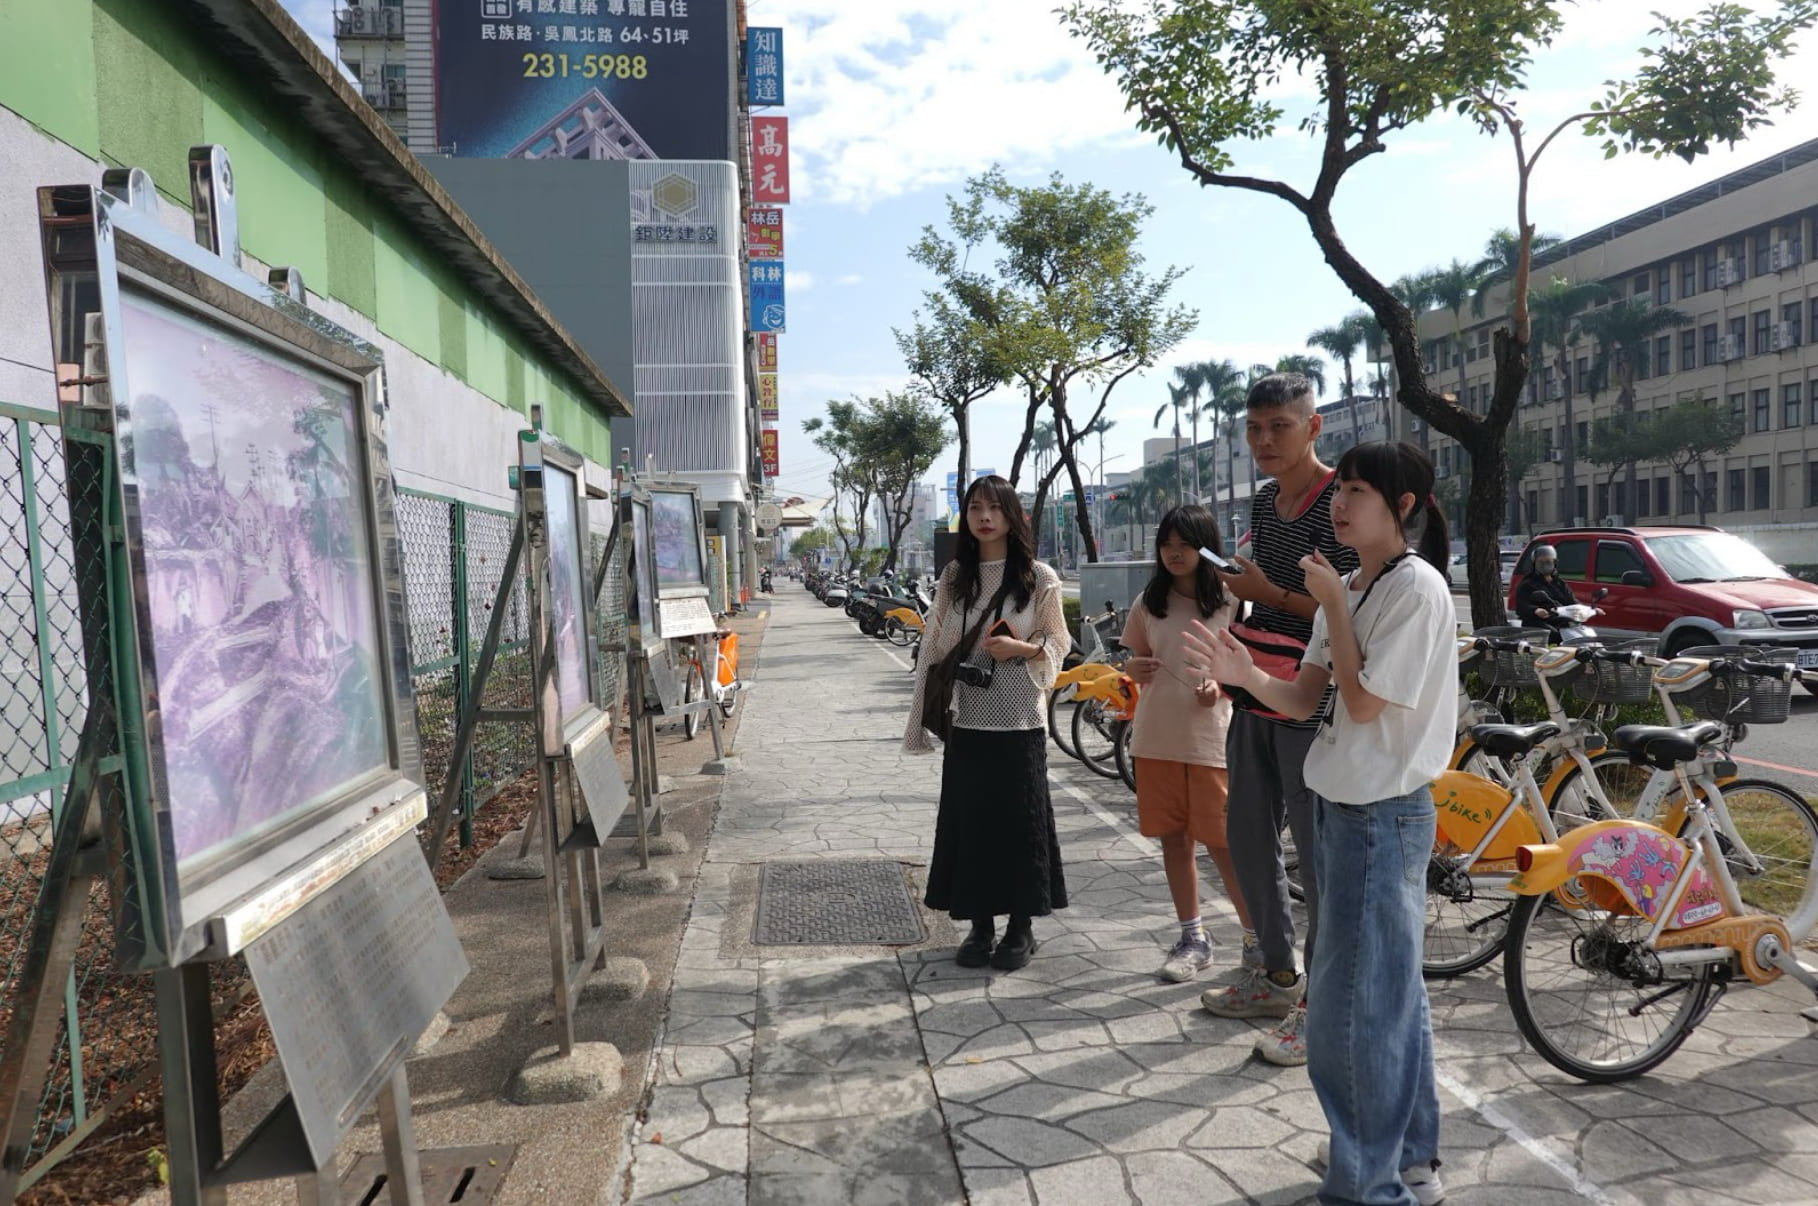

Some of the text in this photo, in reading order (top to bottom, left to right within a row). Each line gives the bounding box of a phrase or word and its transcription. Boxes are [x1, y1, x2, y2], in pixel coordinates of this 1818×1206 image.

[523, 53, 648, 79] 231-5988
[755, 31, 777, 100] 知識達
[764, 463, 776, 473] 3F
